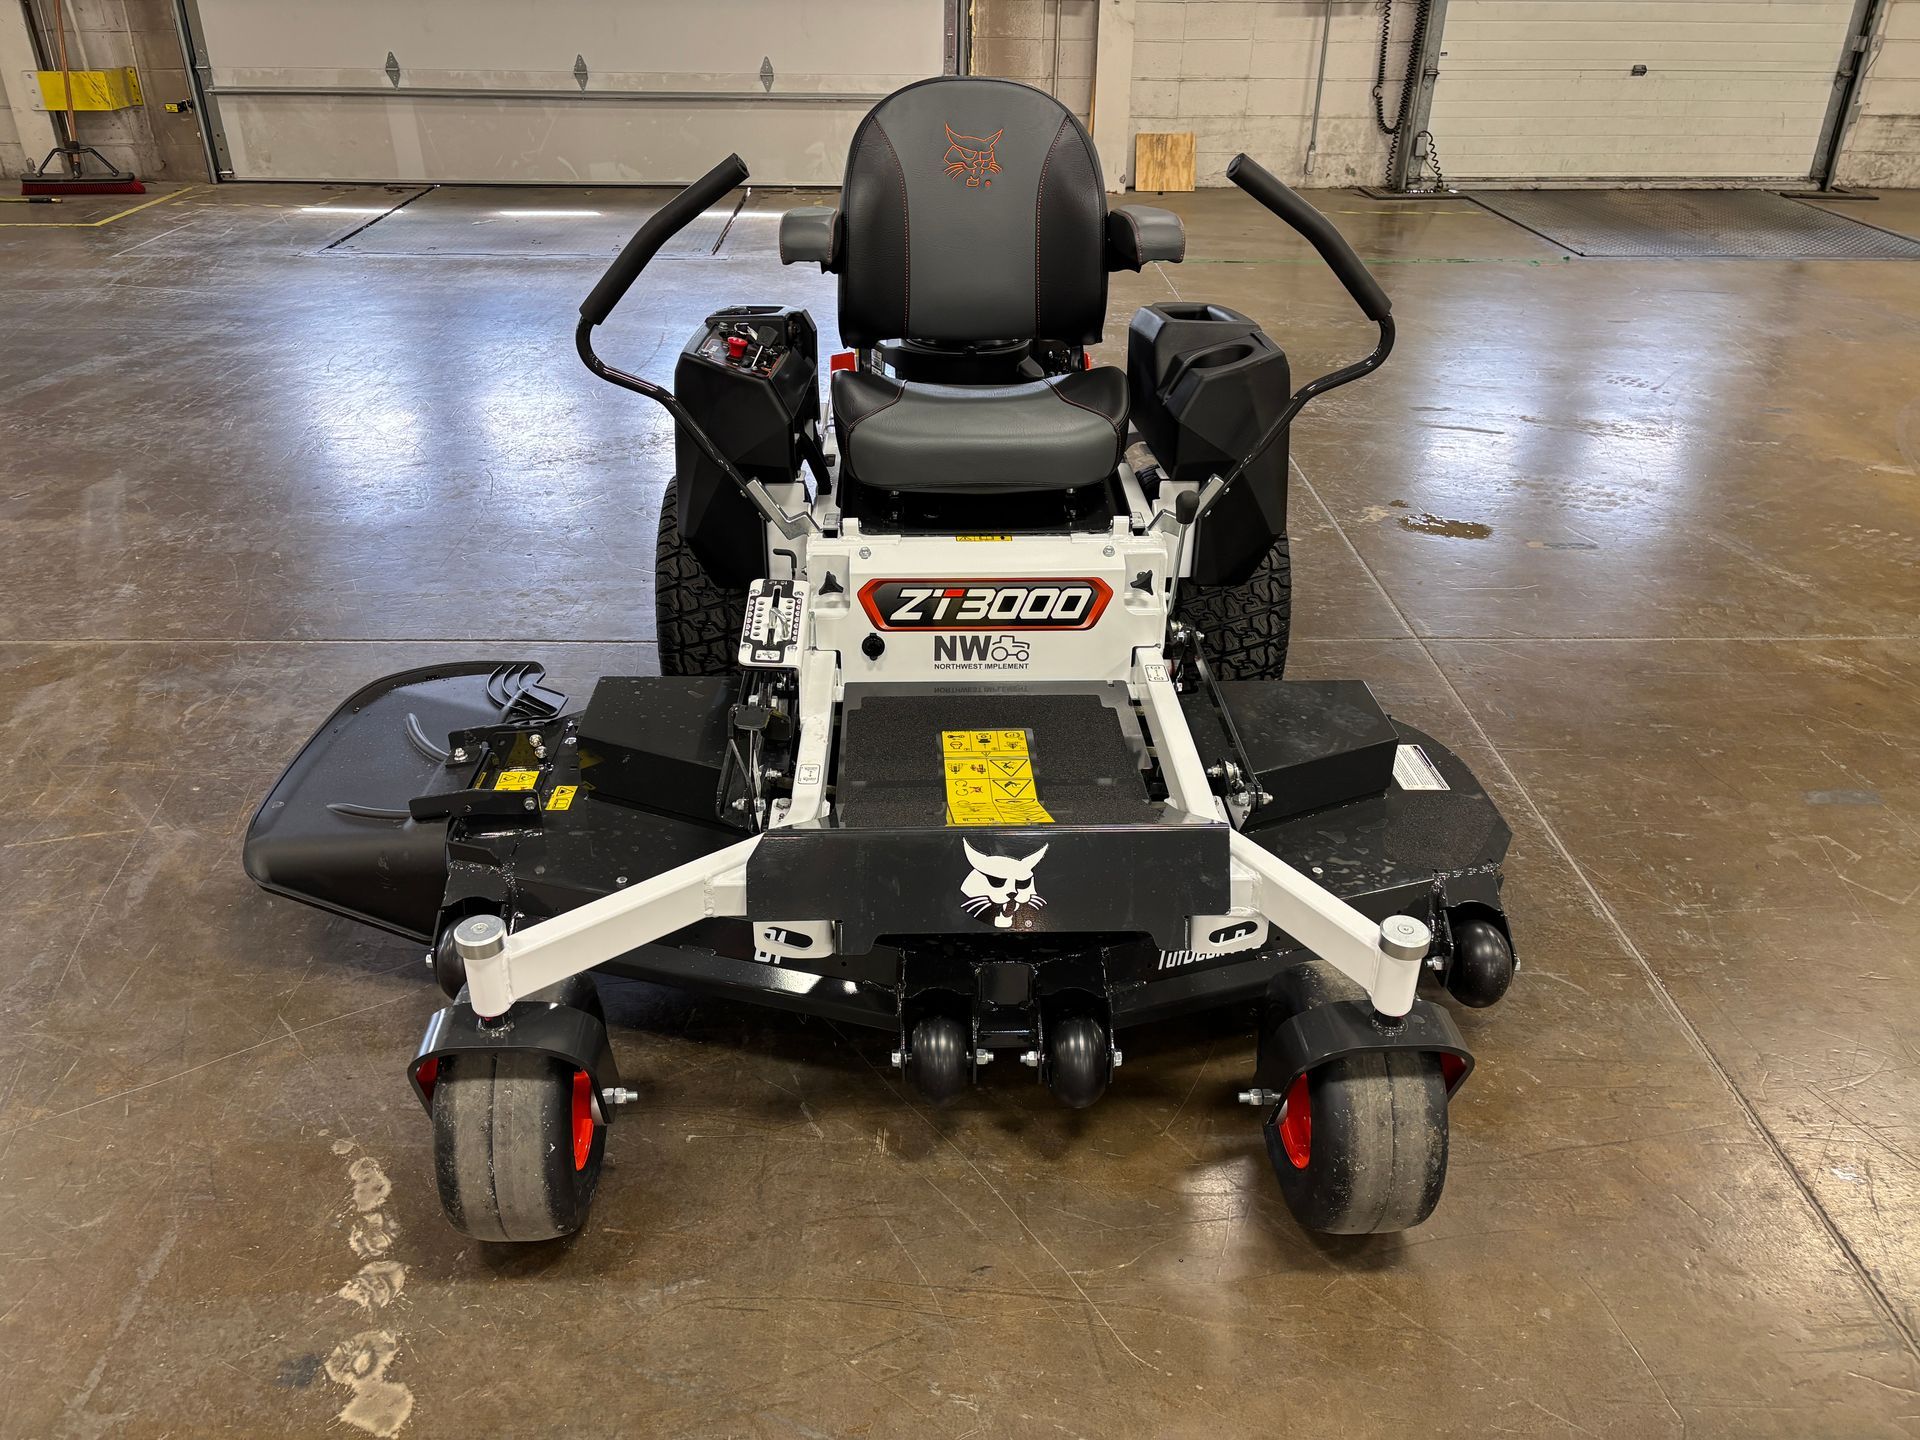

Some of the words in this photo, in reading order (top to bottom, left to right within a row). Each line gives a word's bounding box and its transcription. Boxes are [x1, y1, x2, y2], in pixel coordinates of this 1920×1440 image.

[889, 587, 1093, 621] ZT3000
[934, 635, 992, 661] NW
[984, 662, 1029, 670] IMPLEMENT
